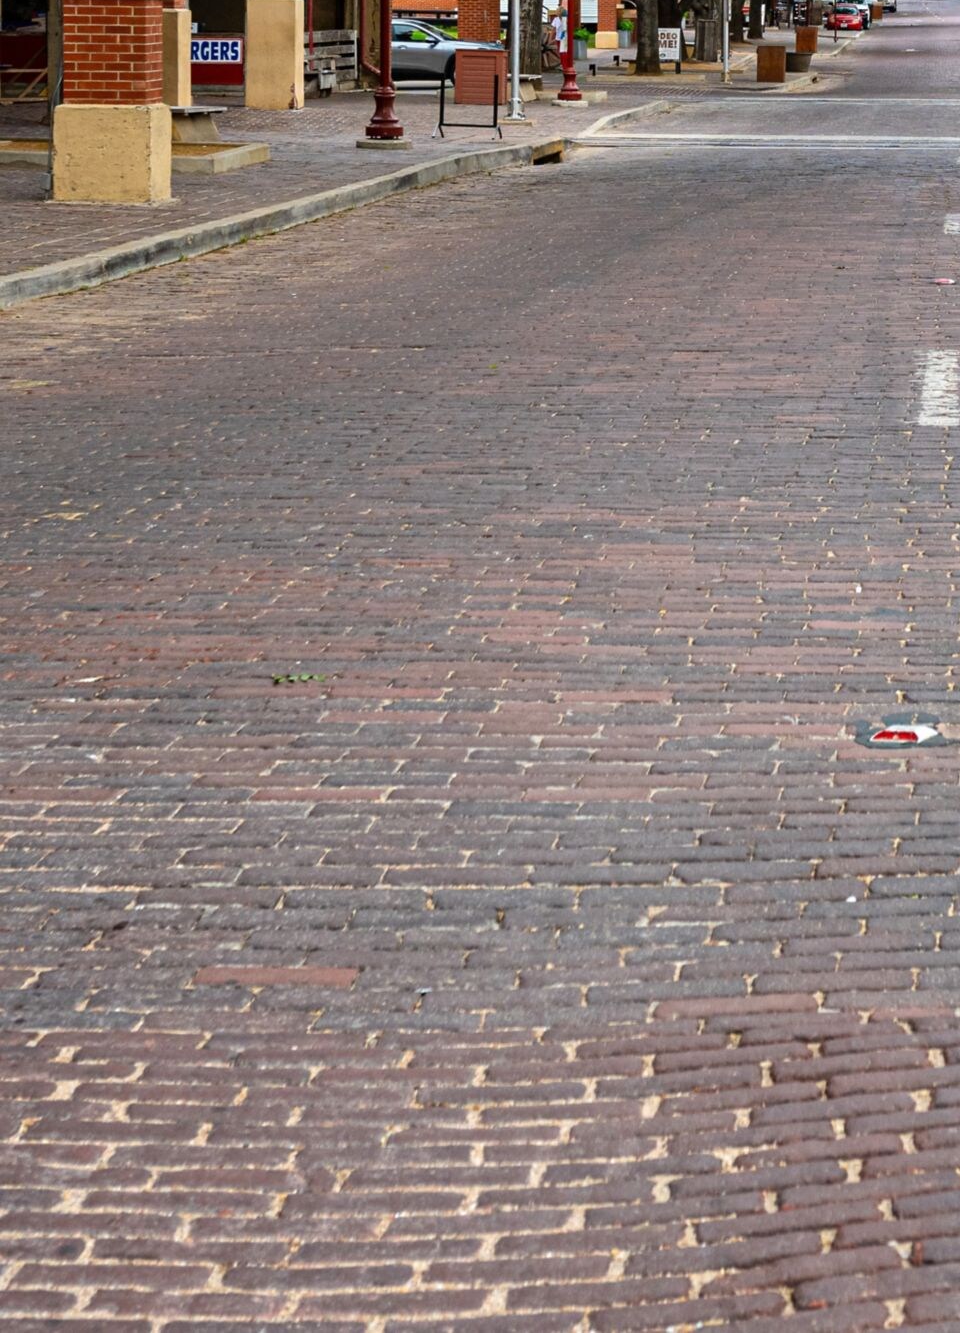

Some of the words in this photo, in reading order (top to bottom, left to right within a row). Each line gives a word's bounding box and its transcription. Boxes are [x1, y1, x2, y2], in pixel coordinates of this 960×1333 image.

[660, 32, 678, 40] DEO
[659, 40, 678, 49] ME!
[191, 41, 239, 61] RGERS
